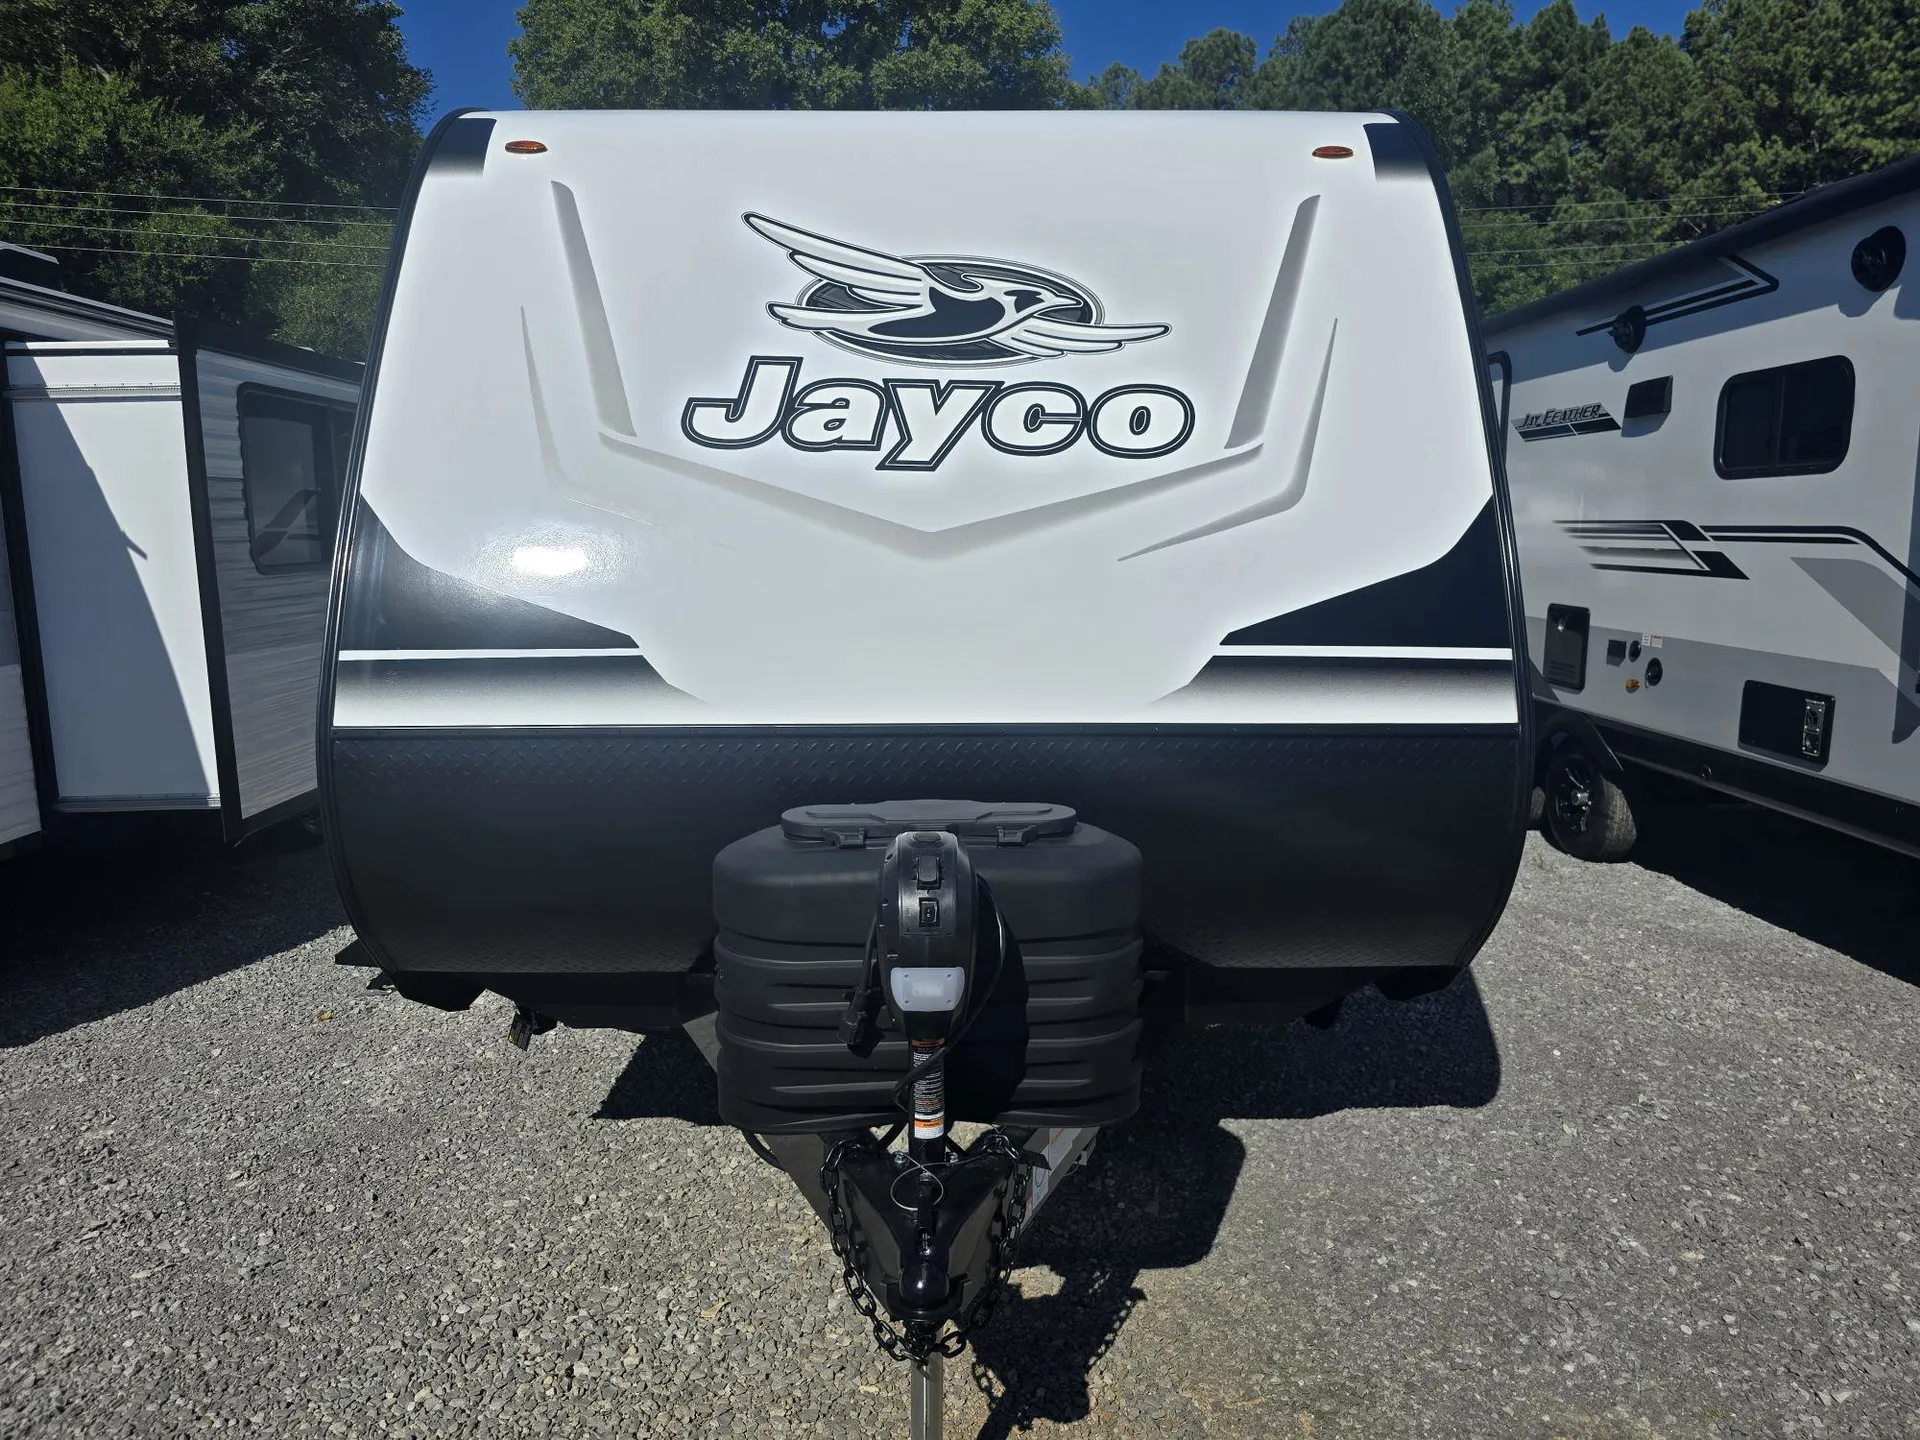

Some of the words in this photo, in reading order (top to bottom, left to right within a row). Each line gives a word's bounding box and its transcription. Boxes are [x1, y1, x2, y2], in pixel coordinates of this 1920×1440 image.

[681, 356, 1196, 472] Jayco
[1520, 412, 1541, 428] JAY
[1543, 403, 1601, 424] FEATHER
